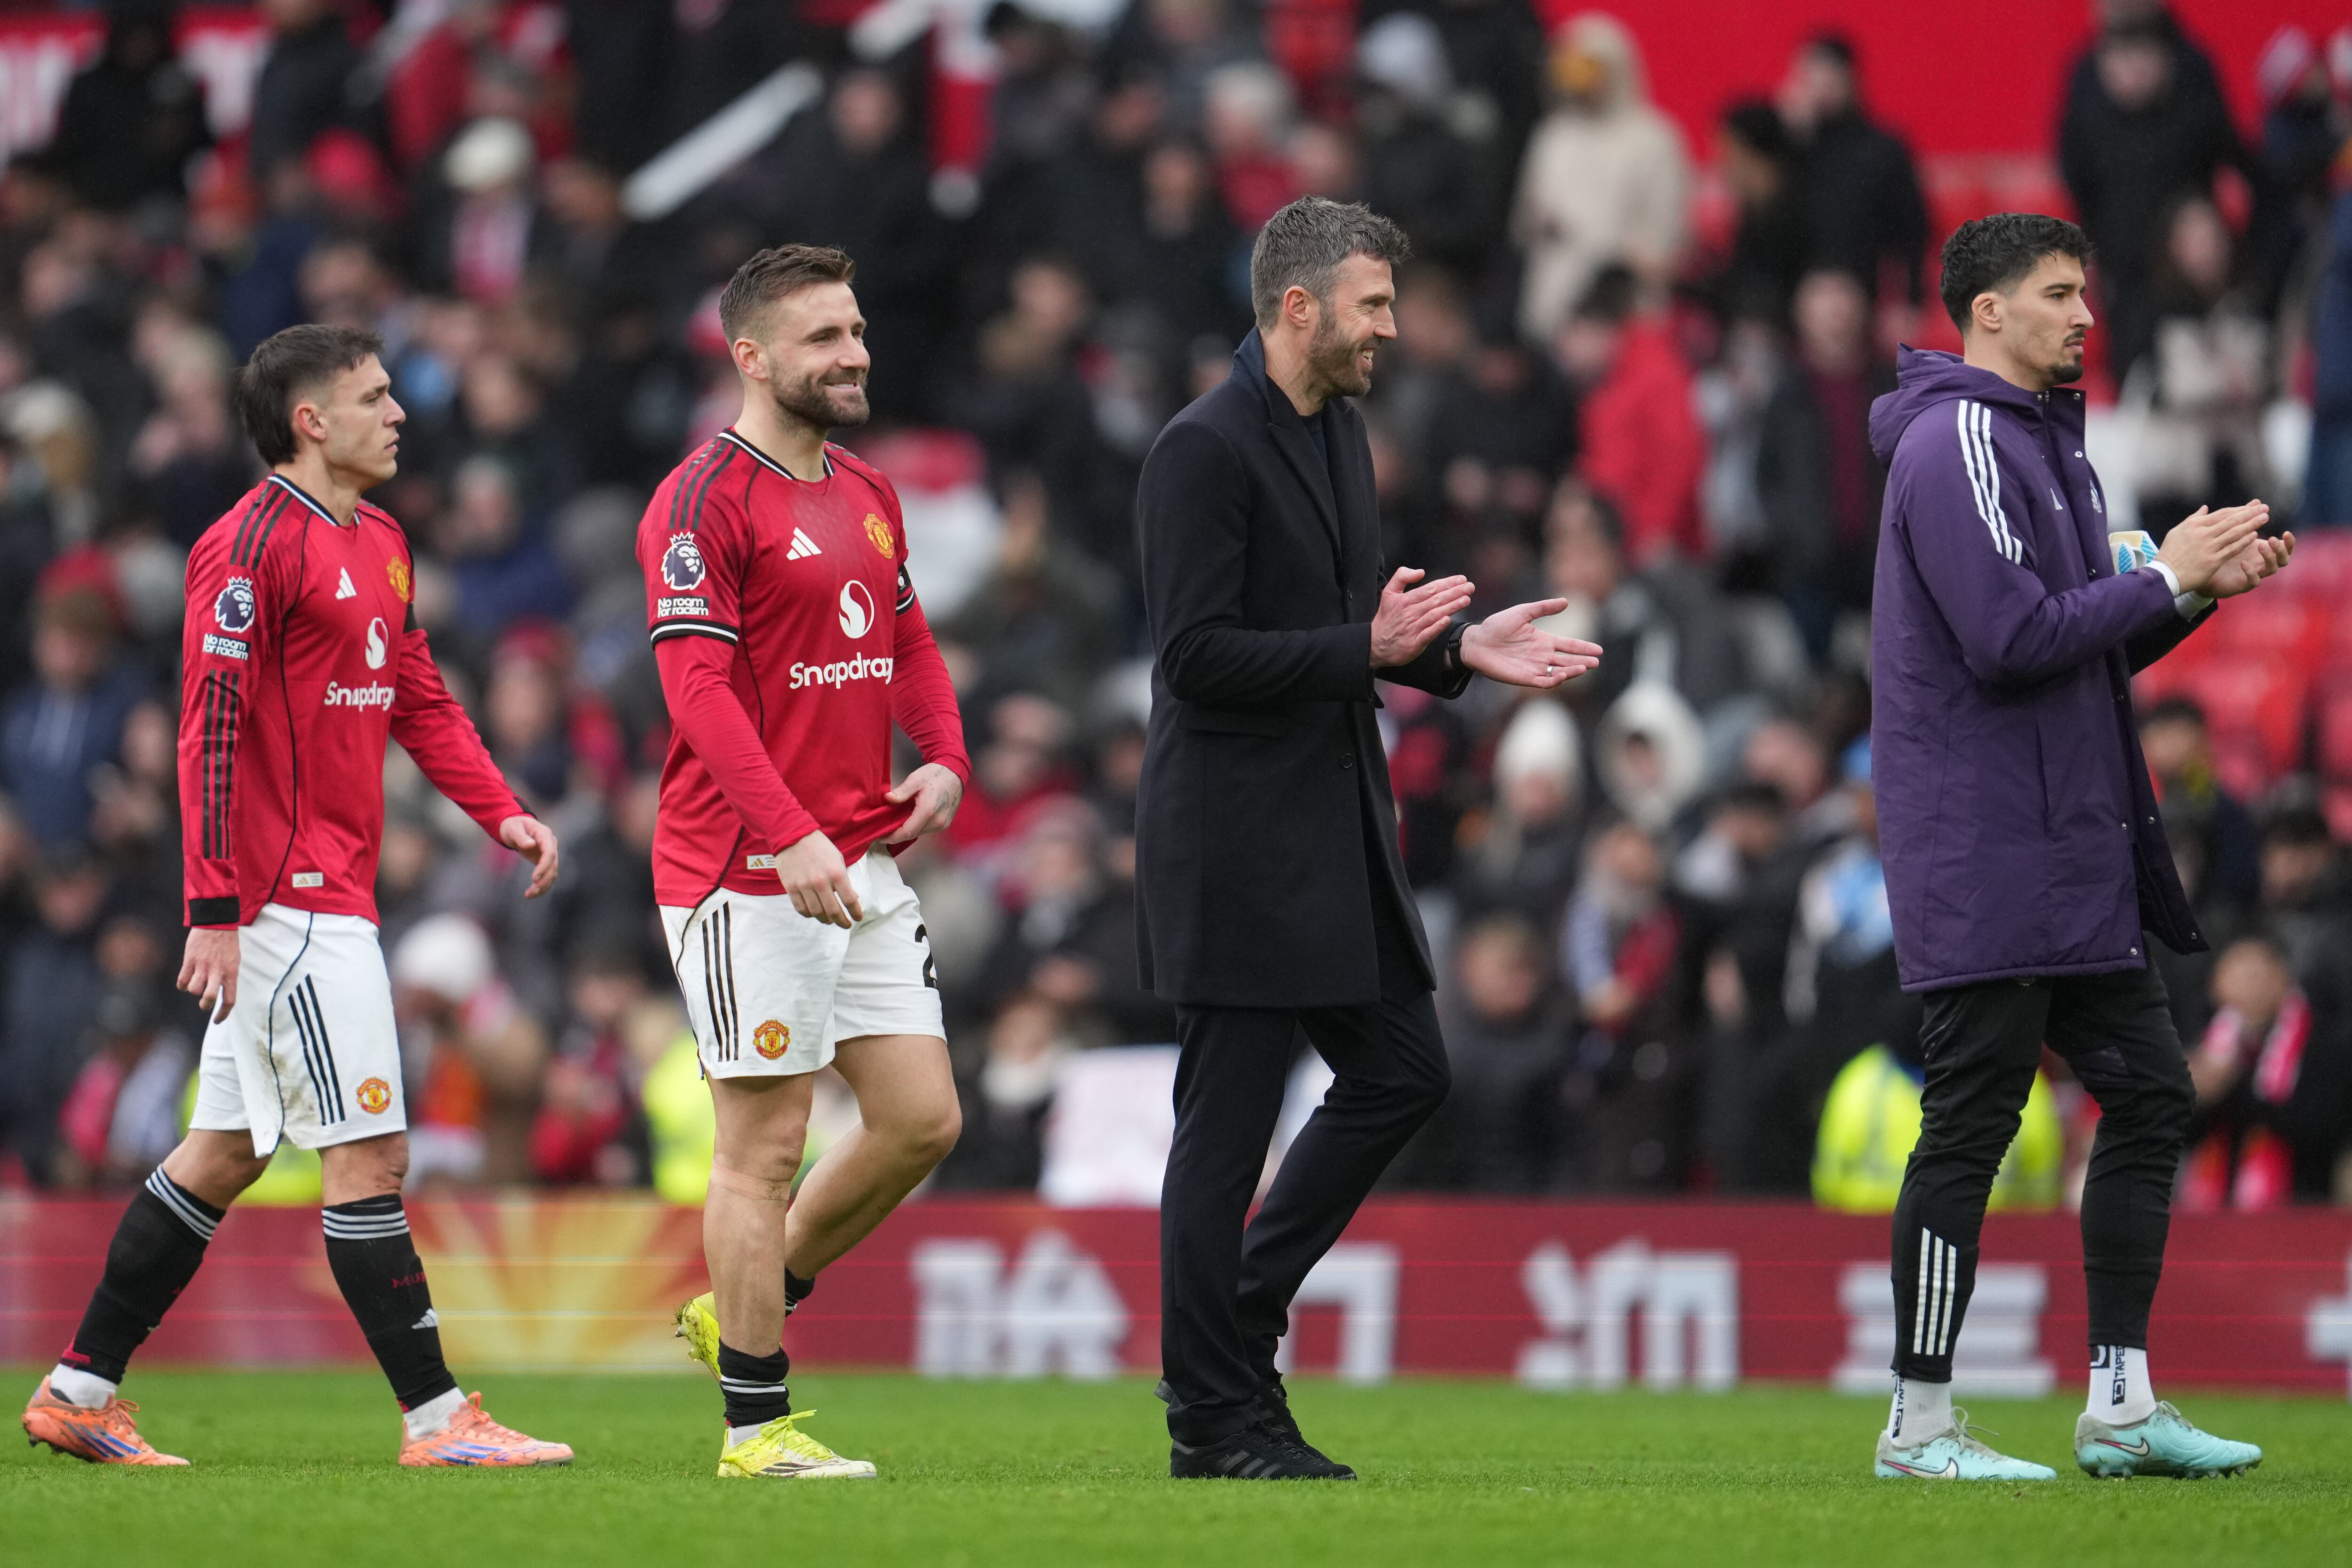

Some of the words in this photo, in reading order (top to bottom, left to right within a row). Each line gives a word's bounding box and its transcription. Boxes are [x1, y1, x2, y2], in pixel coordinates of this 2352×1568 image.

[658, 597, 672, 608] No
[673, 597, 704, 608] room
[658, 607, 671, 618] for
[672, 606, 709, 616] racism
[203, 633, 218, 646] No
[218, 637, 246, 651] room
[216, 646, 248, 661] racism
